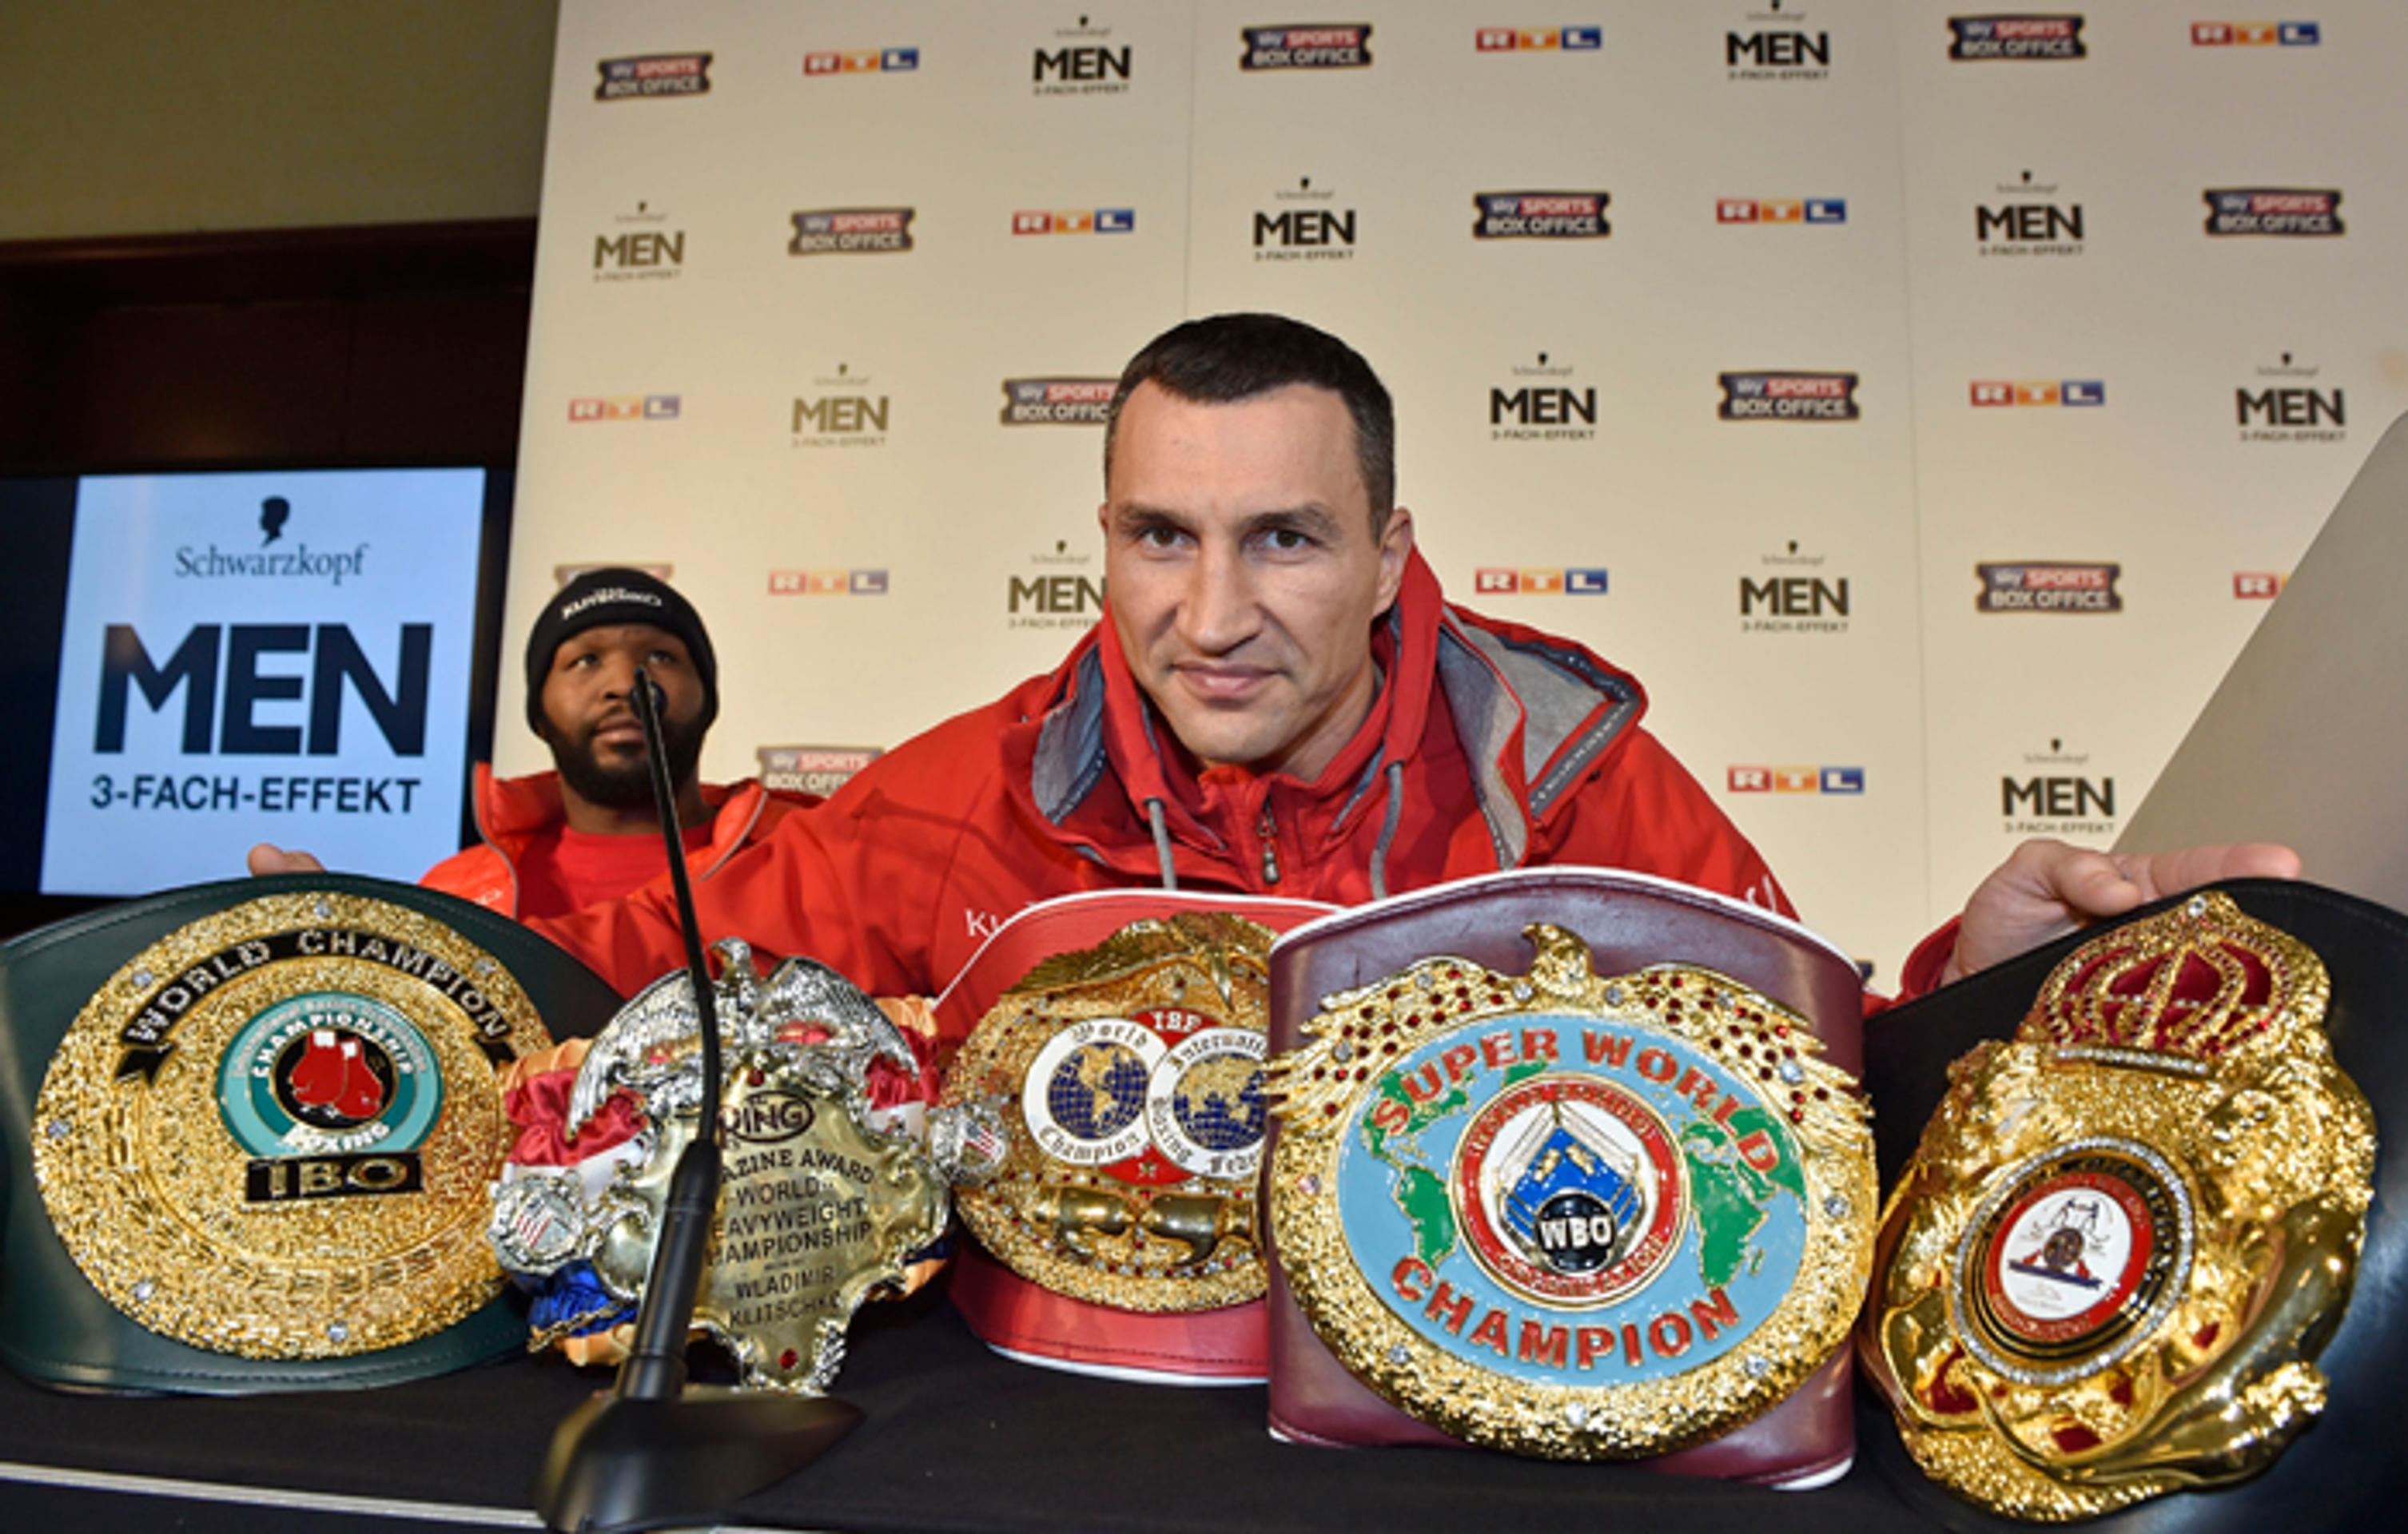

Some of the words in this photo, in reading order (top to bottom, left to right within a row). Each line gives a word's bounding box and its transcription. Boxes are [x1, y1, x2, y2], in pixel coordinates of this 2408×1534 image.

[1286, 30, 1359, 47] SPORTS
[1479, 27, 1599, 50] RTL
[1996, 20, 2071, 37] SPORTS
[2194, 23, 2317, 44] RTL
[1252, 49, 1291, 66] BOX
[1294, 47, 1359, 64] OFFICE
[1727, 31, 1829, 66] MEN
[1960, 39, 2001, 55] BOX
[2005, 39, 2072, 55] OFFICE
[636, 58, 700, 76] SPORTS
[807, 50, 917, 74] RTL
[1034, 46, 1132, 82] MEN
[605, 79, 639, 96] BOX
[642, 75, 699, 93] OFFICE
[1520, 197, 1597, 214] SPORTS
[1720, 200, 1844, 221] RTL
[2251, 194, 2330, 211] SPORTS
[833, 214, 902, 232] SPORTS
[1014, 210, 1132, 233] RTL
[1253, 209, 1356, 246] MEN
[1486, 217, 1526, 233] BOX
[1529, 217, 1598, 233] OFFICE
[1976, 204, 2084, 241] MEN
[2216, 213, 2260, 231] BOX
[2263, 213, 2332, 231] OFFICE
[594, 230, 684, 269] MEN
[800, 233, 838, 250] BOX
[839, 232, 902, 249] OFFICE
[1766, 378, 1845, 396] SPORTS
[1973, 383, 2102, 405] RTL
[571, 397, 678, 420] RTL
[791, 395, 890, 433] MEN
[1014, 403, 1051, 420] BOX
[1052, 403, 1109, 421] OFFIC
[1491, 387, 1596, 425] MEN
[1730, 399, 1773, 416] BOX
[1776, 399, 1848, 416] OFFICE
[2235, 387, 2346, 427] MEN
[174, 543, 369, 586] Schwarzkopf
[770, 570, 886, 593] RTL
[1478, 570, 1605, 593] RTL
[2024, 569, 2107, 587] SPORTS
[1009, 575, 1107, 614] MEN
[1741, 577, 1849, 617] MEN
[1989, 590, 2035, 607] BOX
[2036, 590, 2109, 607] OFFICE
[94, 622, 434, 757] MEN
[765, 773, 802, 789] BOX
[1729, 768, 1861, 792] RTL
[90, 774, 421, 813] 3-FACH-EFFEKT
[2002, 777, 2114, 817] MEN
[126, 941, 271, 1043] WORLD
[297, 928, 511, 1037] CHAMPION
[1153, 1010, 1203, 1032] IBF
[1373, 1027, 1560, 1135] SUPER
[1581, 1029, 1781, 1173] WORLD
[800, 1148, 876, 1184] AWARD
[268, 1158, 408, 1198] IBO
[735, 1175, 820, 1207] WORLD
[1540, 1215, 1612, 1250] WBO
[1391, 1257, 1741, 1369] CHAMPION
